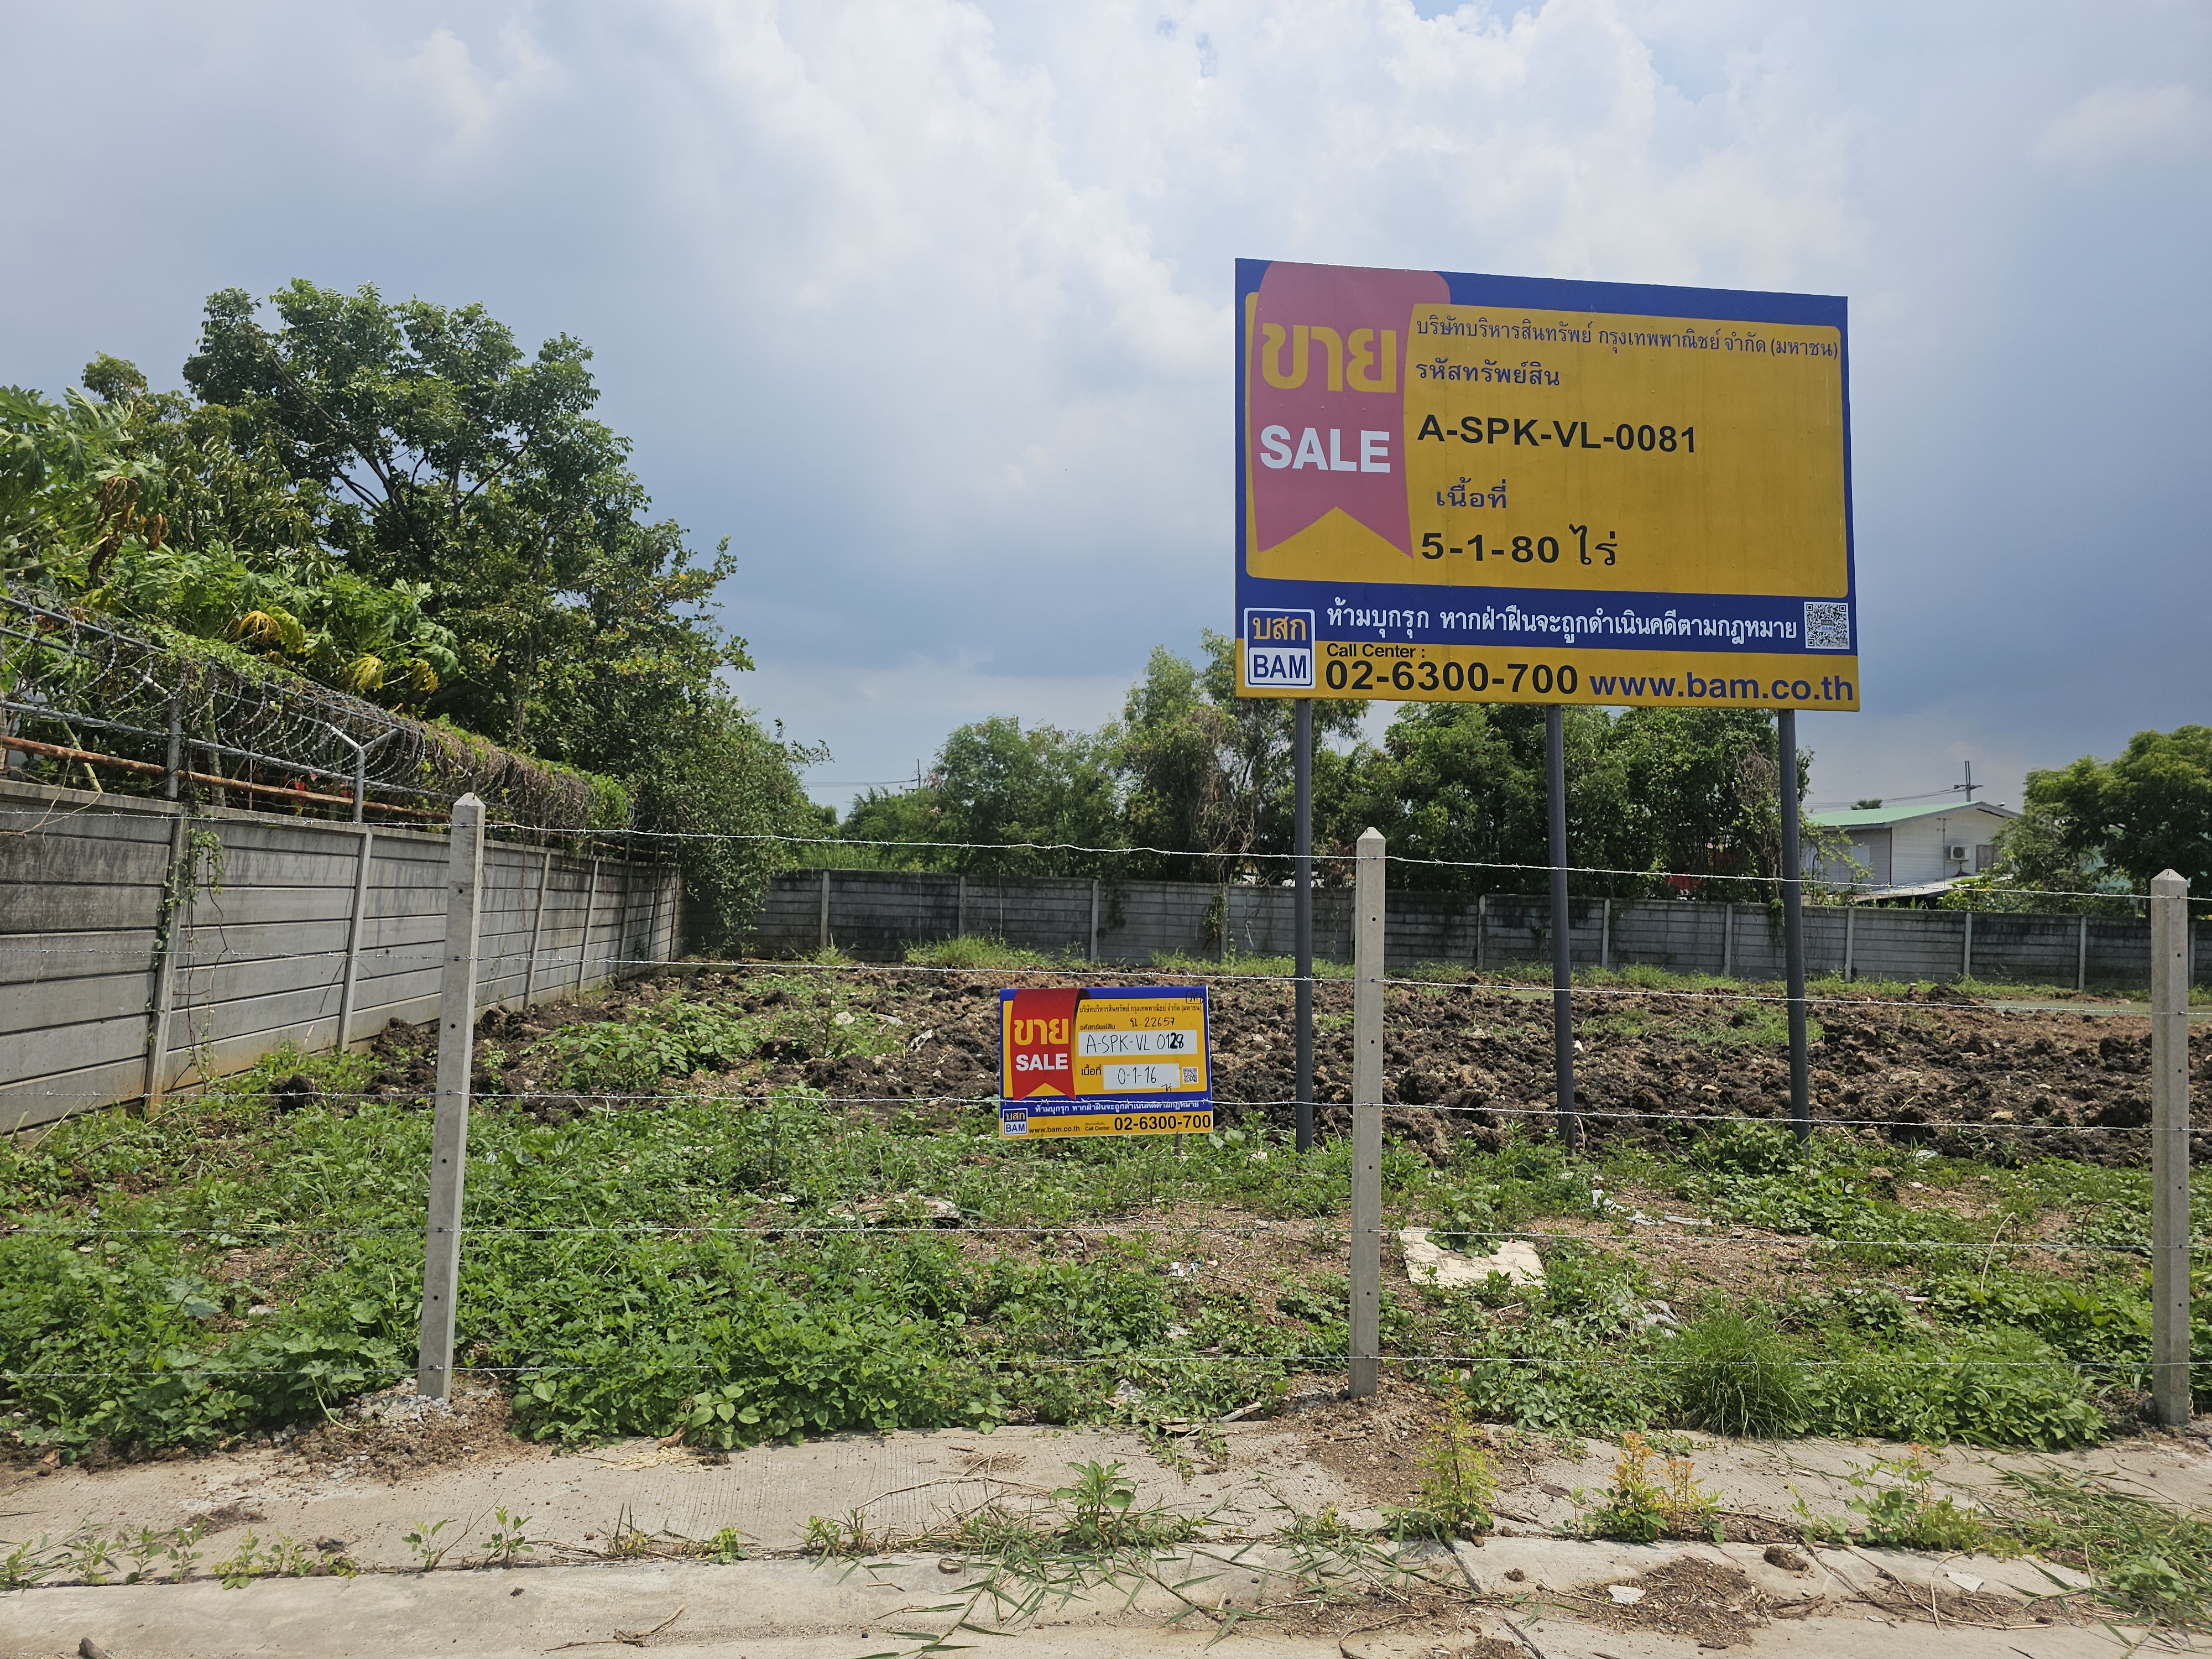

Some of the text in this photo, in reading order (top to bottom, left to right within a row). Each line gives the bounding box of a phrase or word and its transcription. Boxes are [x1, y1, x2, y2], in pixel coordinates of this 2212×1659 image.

[1417, 314, 1838, 359] บริษัทบริหารสินทรัพย์ กรุงเทพพาณิชย์ จำกัด (มหาชน)
[1262, 322, 1397, 393] ขาย
[1416, 357, 1560, 386] รหัสทรัพย์สิน
[1417, 414, 1695, 453] A-SPK-VL-0081
[1260, 425, 1391, 473] SALE
[1437, 477, 1507, 508] เนื้อที่
[1421, 523, 1618, 566] 5-1-80 ไร่
[1252, 615, 1307, 641] บสก
[1327, 597, 1797, 645] ห้ามบุกรุก หากฝ่าฝืนจะถูกดำเนินคดีตามกฎหมาย
[1327, 643, 1357, 658] Call
[1361, 644, 1416, 658] Center
[1253, 654, 1307, 680] BAM
[1326, 660, 1854, 701] 02-6300-700 www.bam.co.th
[1079, 1003, 1202, 1014] บริษัทบริหารสินทรัพย์ กรุงเทพพาณิชย์ จำกัด (มหาชน)
[1144, 1016, 1175, 1027] 22657
[1014, 1018, 1069, 1046] ขาย
[1015, 1053, 1068, 1071] SALE
[1081, 1064, 1102, 1076] เนื้อที่
[1118, 1066, 1157, 1084] 0-1-16
[1005, 1112, 1025, 1121] บสก
[1035, 1100, 1199, 1115] ห้ามบุกรุก หากฝ่าฝืนจะถูกดำเนนคดตามกฎหมาย
[1005, 1124, 1025, 1133] BAM
[1114, 1114, 1211, 1131] 02-6300-700
